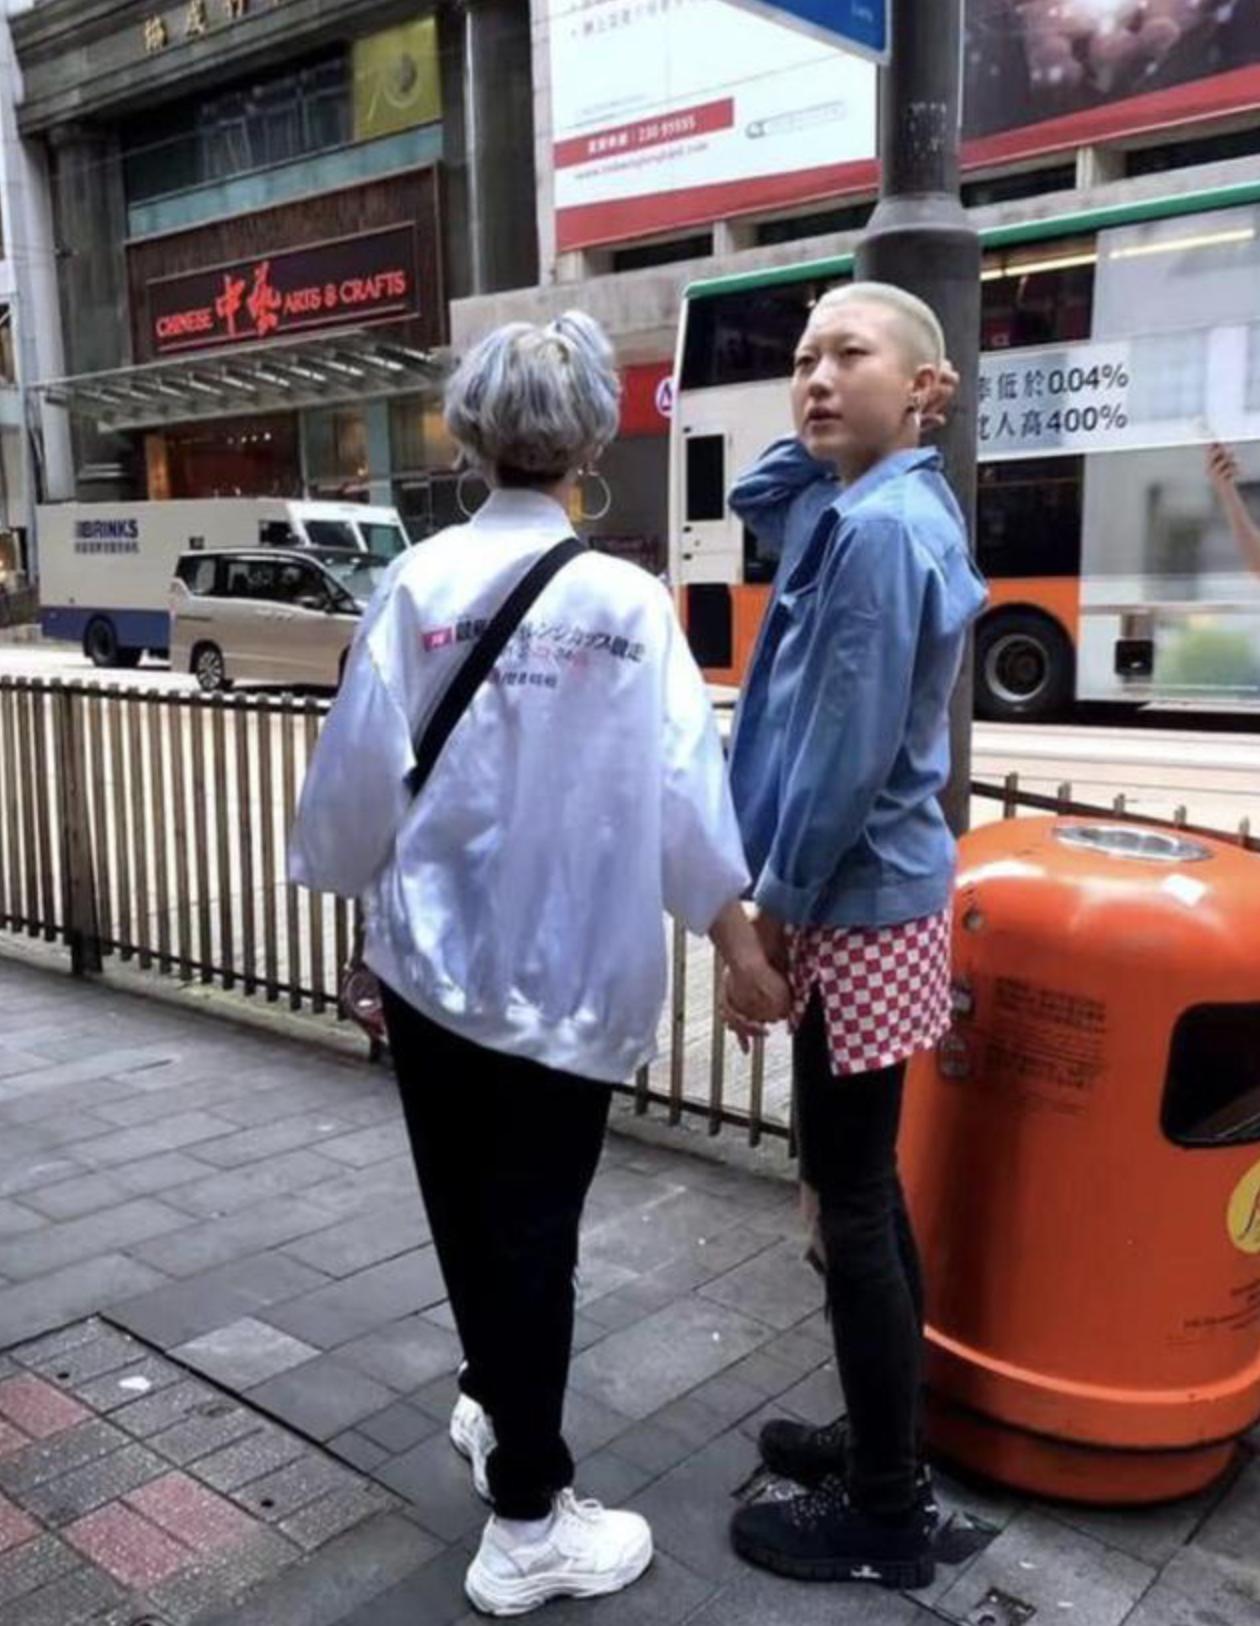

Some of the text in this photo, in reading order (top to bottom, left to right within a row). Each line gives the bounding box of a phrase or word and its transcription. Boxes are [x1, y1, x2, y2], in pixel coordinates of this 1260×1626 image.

[156, 308, 213, 337] CHINESE
[283, 287, 322, 315] ARTS
[339, 271, 406, 304] CRAFTS
